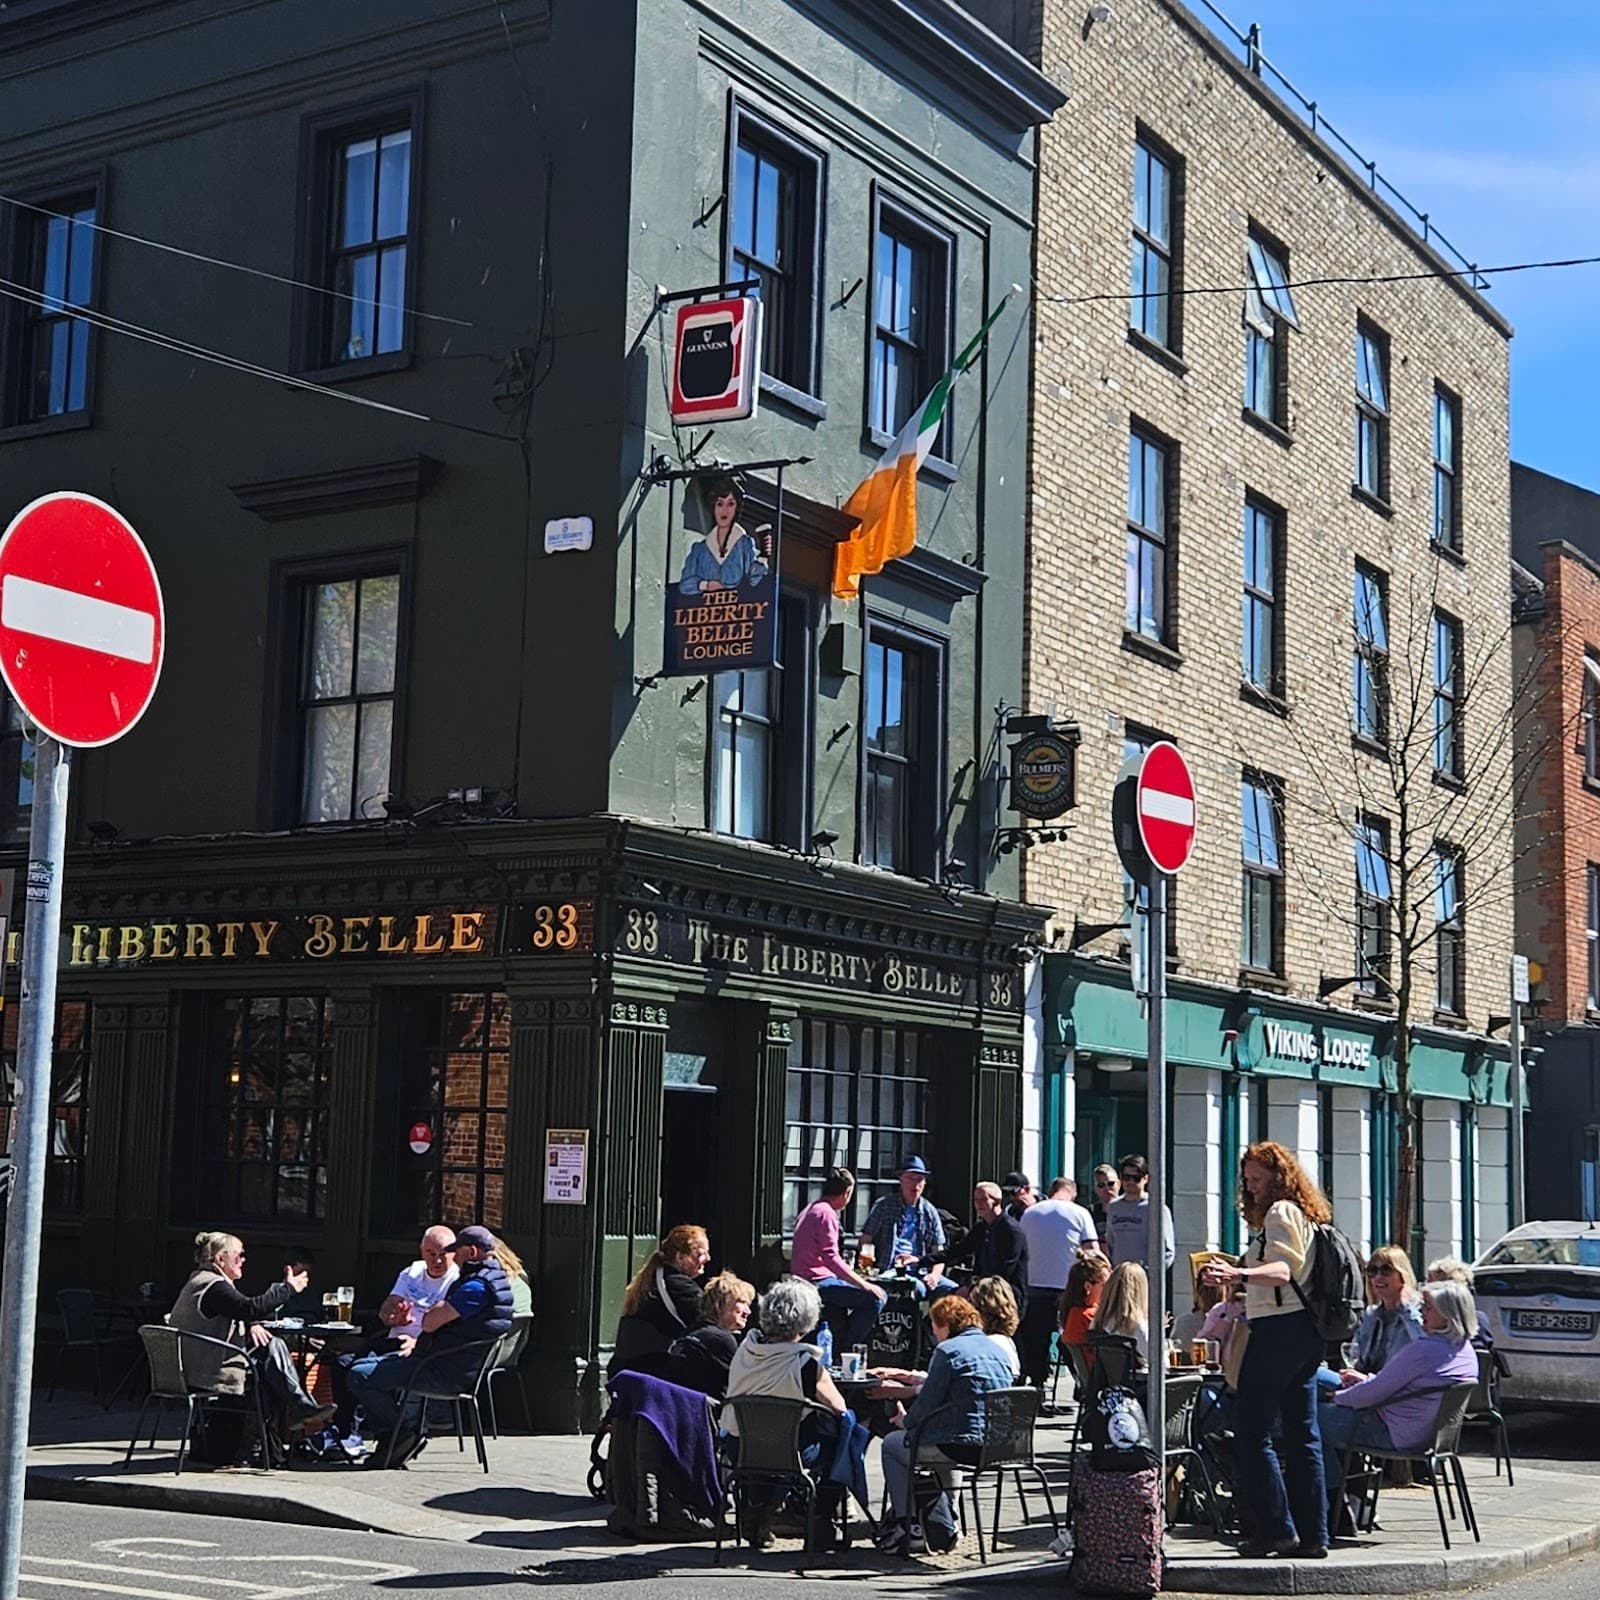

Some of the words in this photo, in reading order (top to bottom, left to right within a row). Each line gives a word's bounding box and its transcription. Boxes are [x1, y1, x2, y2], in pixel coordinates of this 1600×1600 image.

[686, 341, 728, 353] GUINNESS
[702, 590, 738, 606] THE
[673, 601, 768, 626] LIBERTY
[685, 621, 754, 644] BELLE
[683, 641, 753, 660] LOUNGE
[1018, 763, 1067, 775] BULMERS
[70, 920, 279, 965] LIBERTY
[304, 911, 487, 958] BELLE
[532, 903, 579, 950] 33
[626, 908, 659, 955] 33
[687, 918, 749, 964] THE
[761, 930, 877, 983] LIBERTY
[882, 952, 963, 997] BELLE
[990, 971, 1012, 1006] 33
[1265, 1021, 1318, 1060] VIKING
[1322, 1034, 1371, 1068] LODGE
[878, 1311, 913, 1330] EELING
